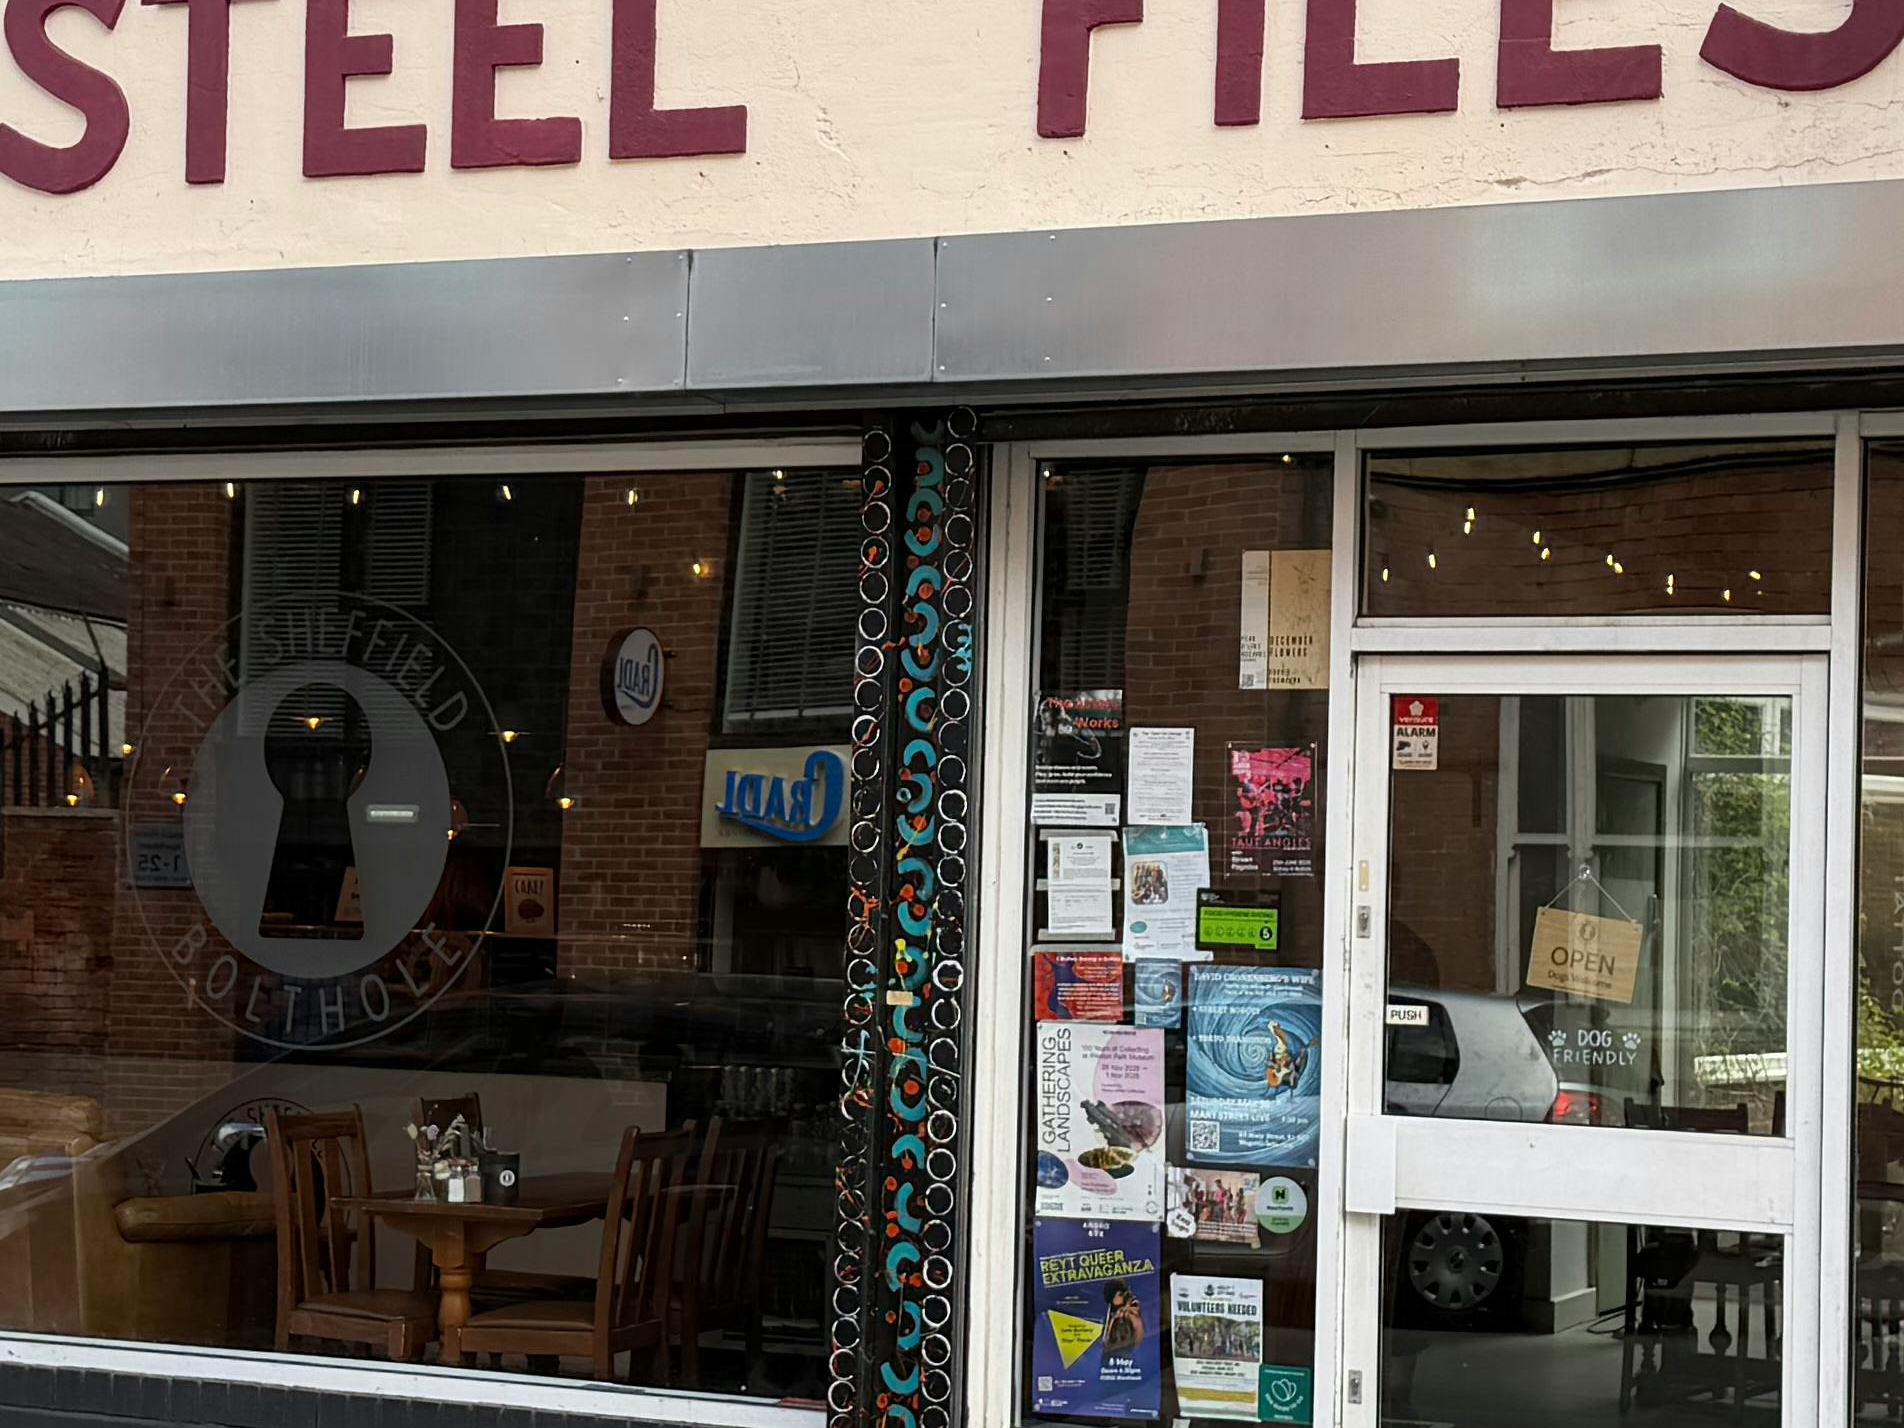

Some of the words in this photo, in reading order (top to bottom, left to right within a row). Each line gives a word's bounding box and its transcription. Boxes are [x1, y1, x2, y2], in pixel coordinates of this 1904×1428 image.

[174, 641, 243, 729] THE
[258, 608, 469, 733] SHEFFIELD
[1074, 717, 1119, 729] Works
[1397, 727, 1436, 737] ALARM
[1551, 946, 1615, 975] OPEN
[171, 922, 461, 1035] BOLTHOLE
[1390, 1008, 1422, 1022] PUSH
[1577, 1029, 1612, 1048] DOG
[1553, 1048, 1639, 1066] FRIENDLY
[1042, 1036, 1056, 1145] GATHERING
[1056, 1028, 1071, 1152] LANDSCAPES
[1040, 1257, 1078, 1273] REYT
[1079, 1249, 1125, 1268] QUEER
[1042, 1258, 1155, 1285] EXTRAVAGANZA
[1177, 1300, 1224, 1315] VOLUNTEERS
[1227, 1302, 1257, 1317] NEEDED
